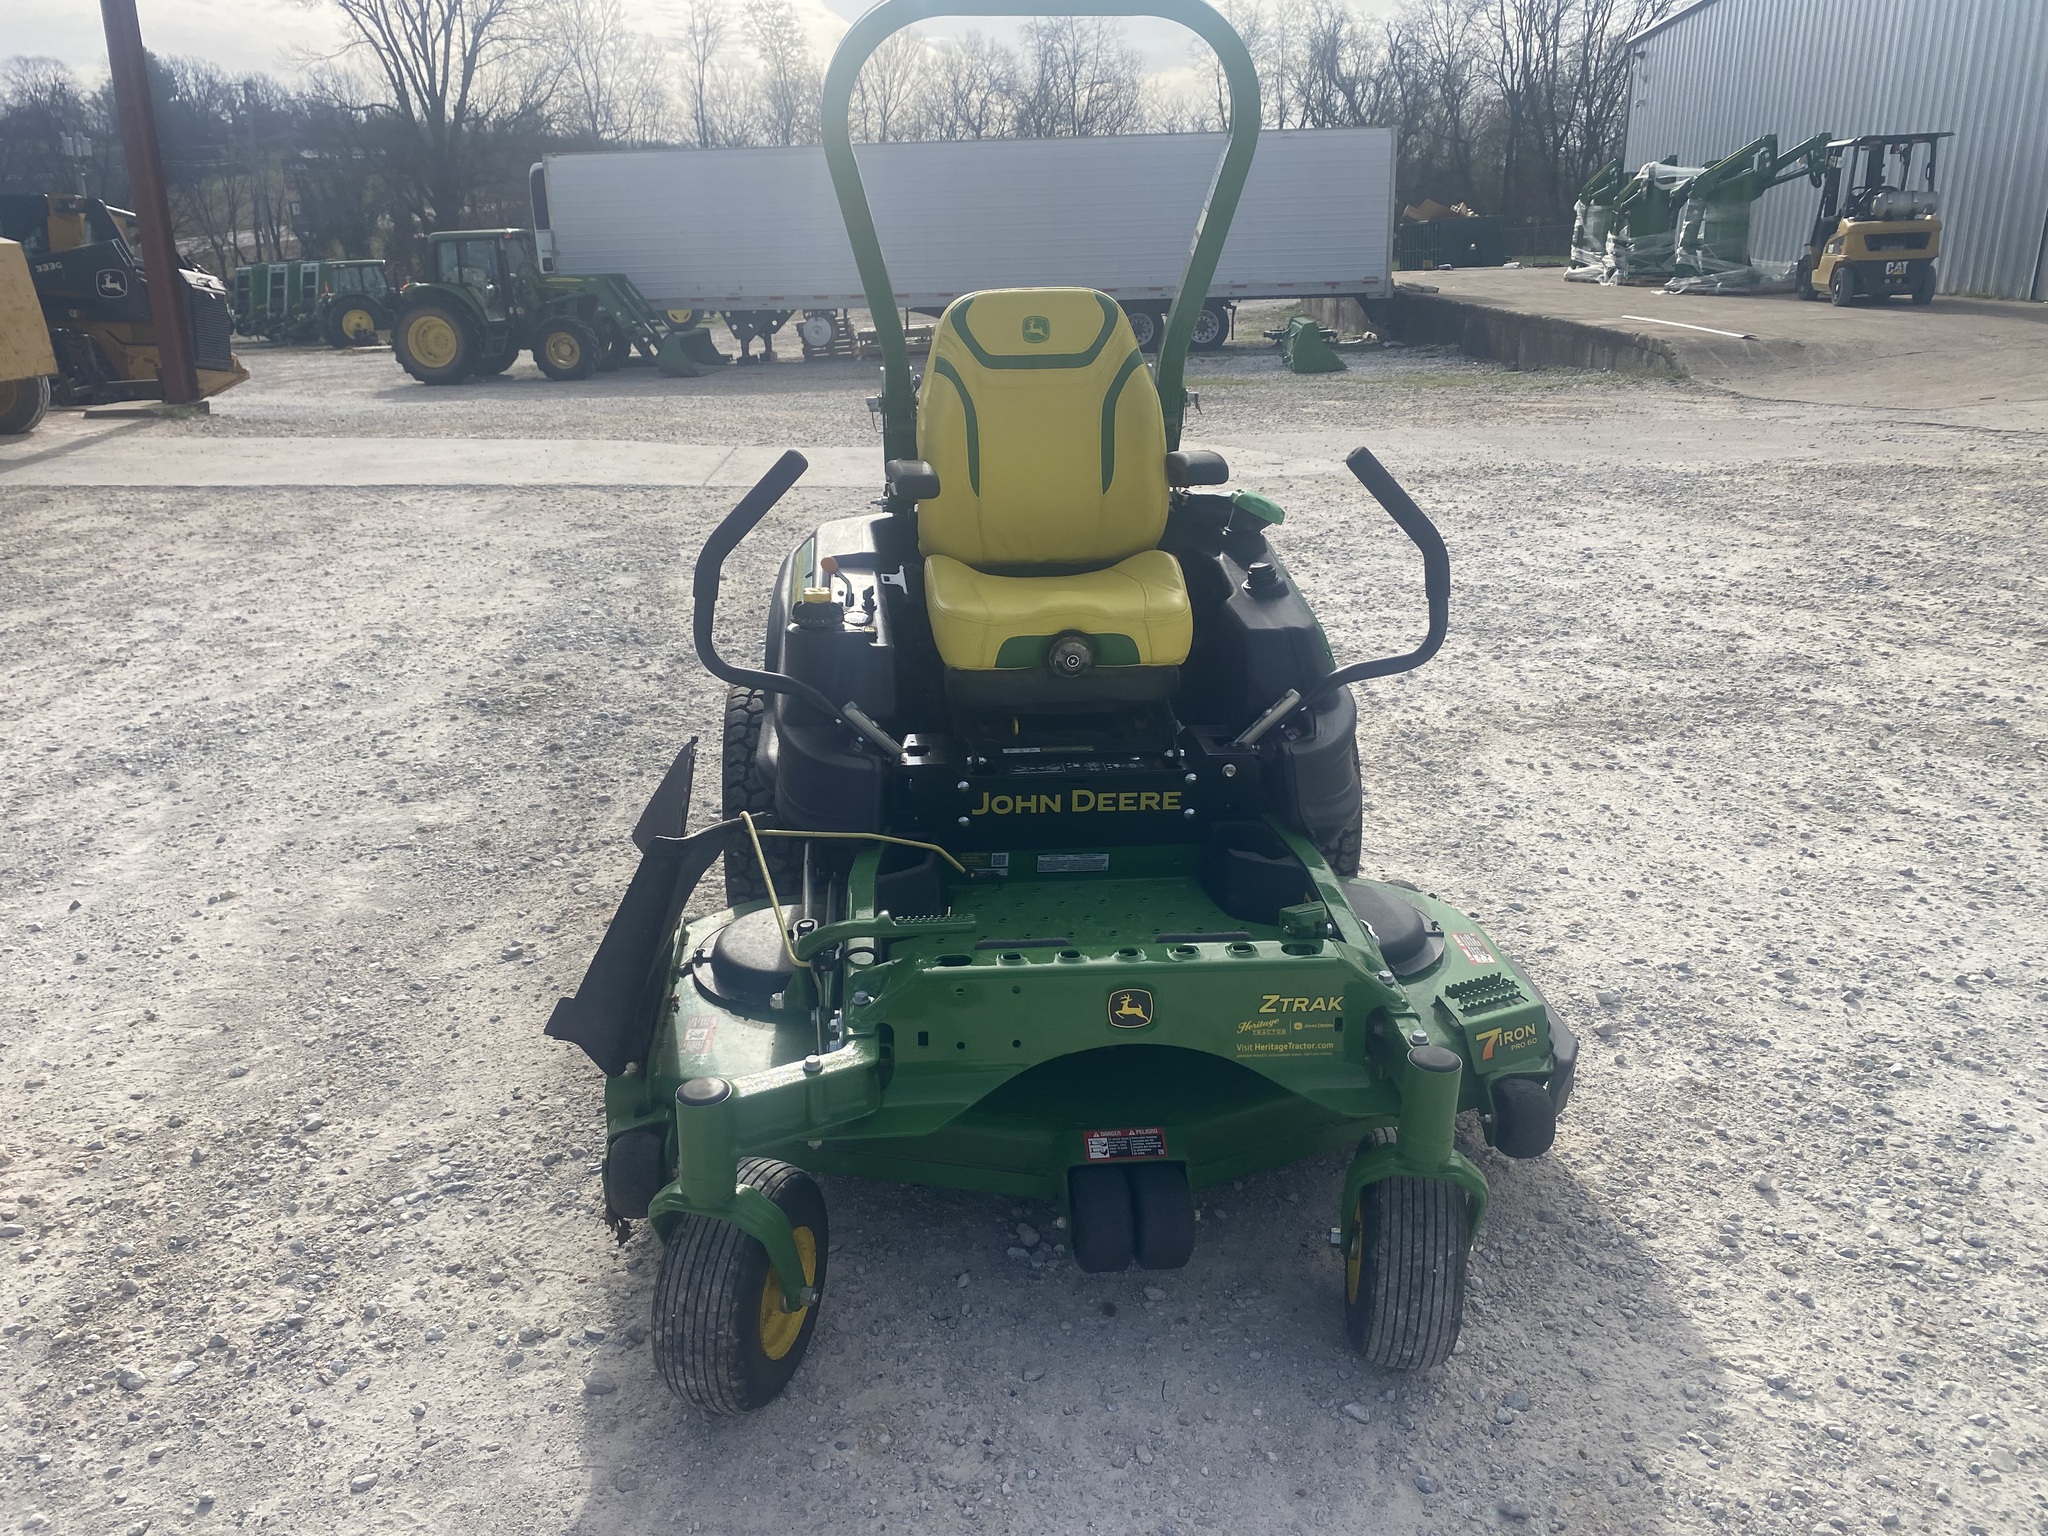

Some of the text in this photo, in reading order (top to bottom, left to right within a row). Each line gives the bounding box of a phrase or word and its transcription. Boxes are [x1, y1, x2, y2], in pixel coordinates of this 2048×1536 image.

[35, 261, 63, 273] 333G
[1885, 261, 1909, 275] CAT
[971, 789, 1182, 815] JOHN DEERE
[1259, 994, 1344, 1013] ZTRAK
[1236, 1018, 1280, 1035] Heritage
[1236, 1042, 1334, 1052] Visit HeritageTractor.com
[1511, 1037, 1537, 1051] PRO 60
